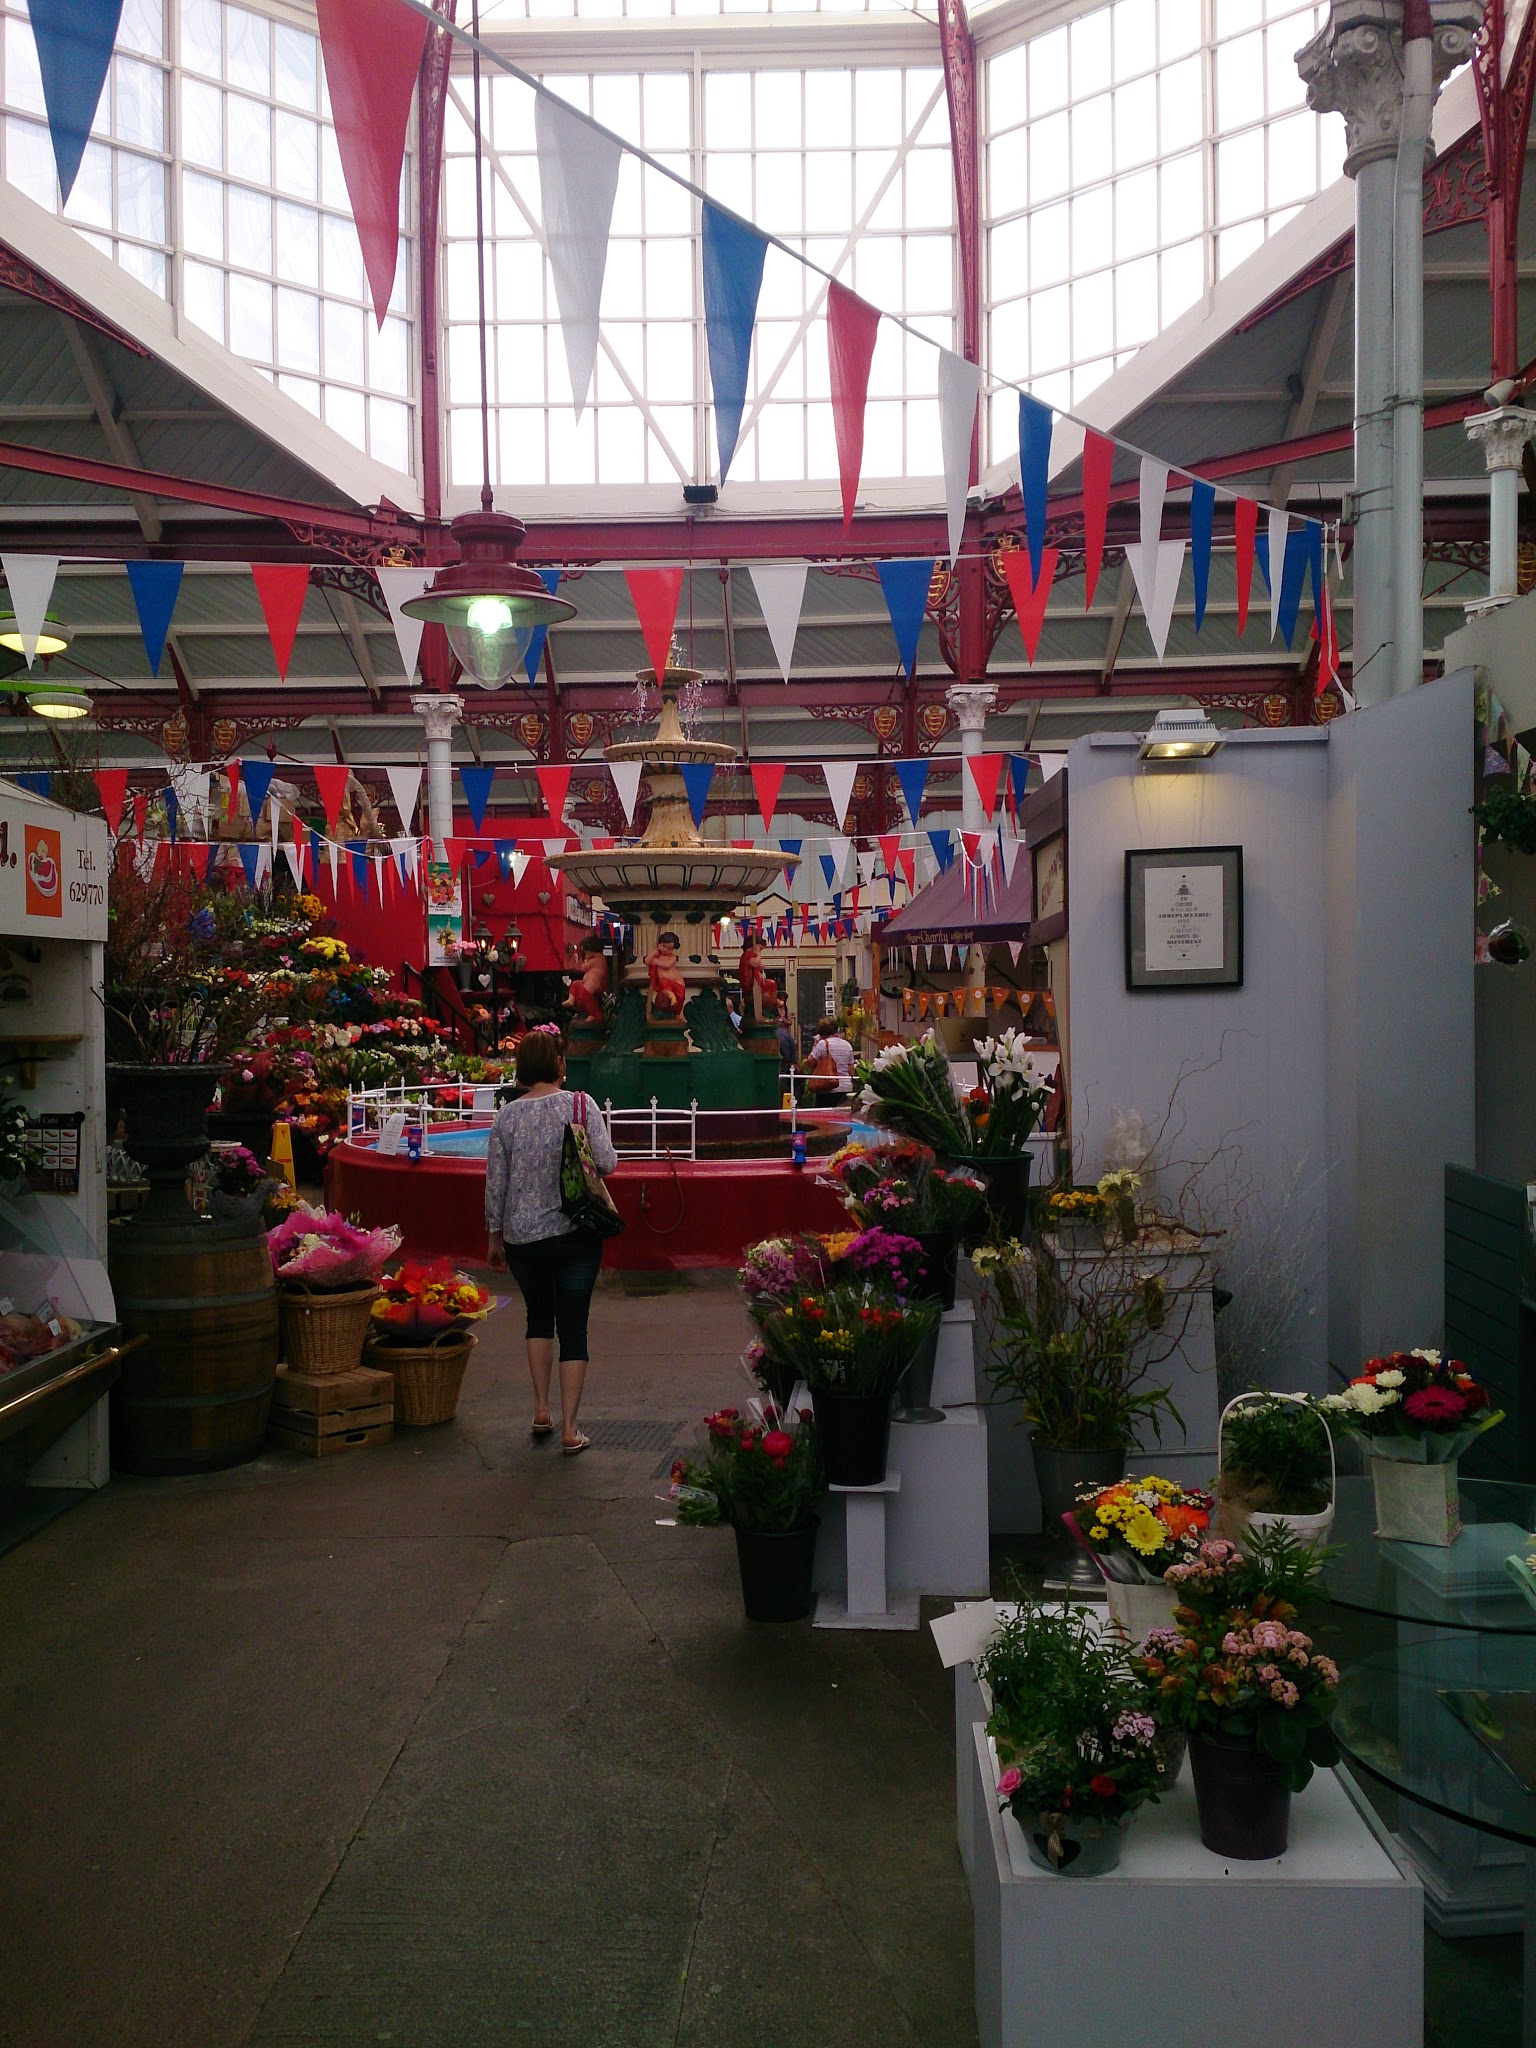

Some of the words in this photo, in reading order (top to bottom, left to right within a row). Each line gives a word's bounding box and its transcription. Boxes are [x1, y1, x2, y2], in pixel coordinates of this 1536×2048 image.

[77, 849, 96, 871] Tel.
[69, 881, 104, 905] 629770
[920, 929, 949, 944] Charity
